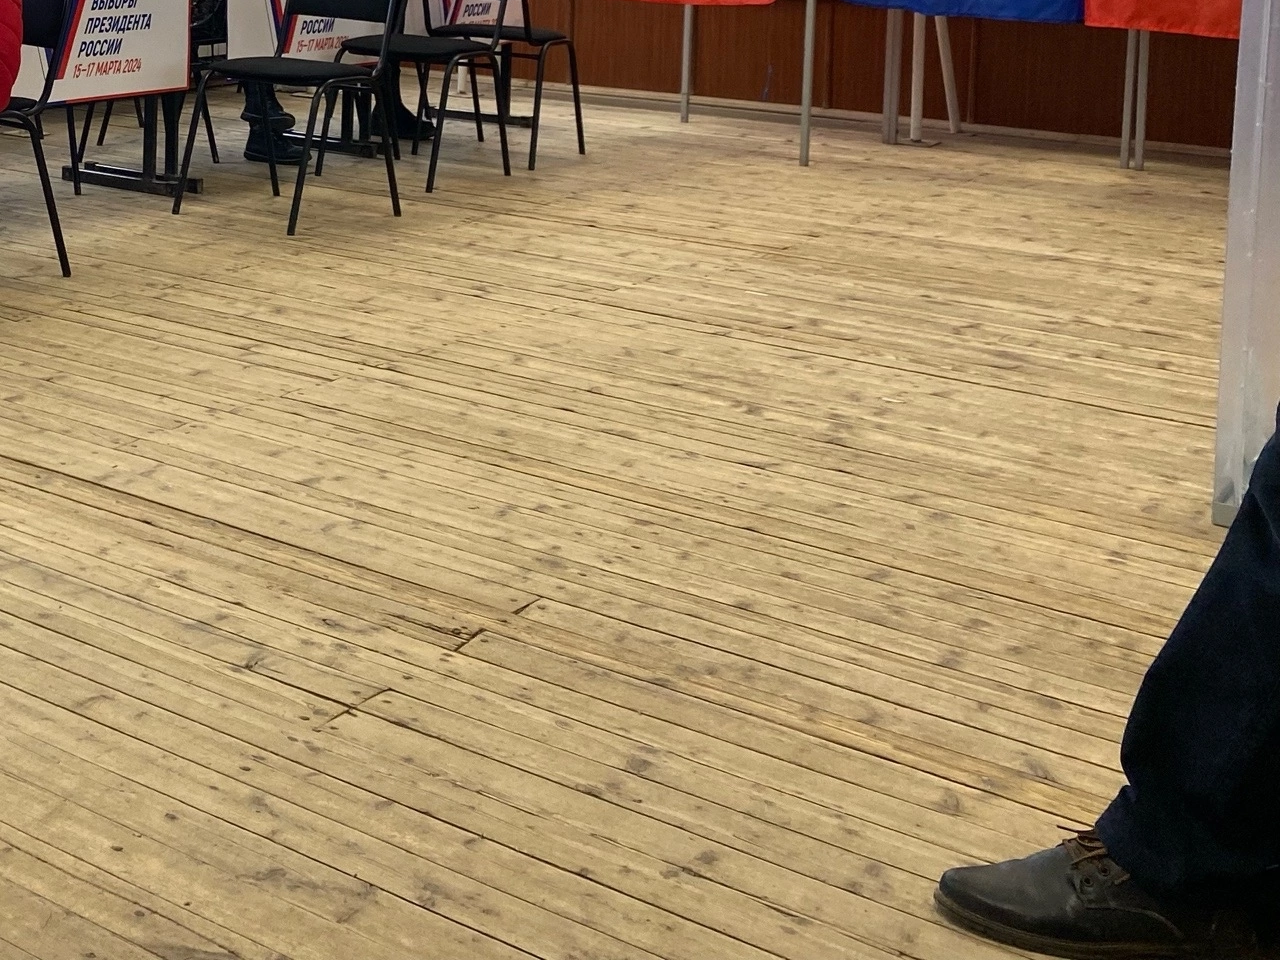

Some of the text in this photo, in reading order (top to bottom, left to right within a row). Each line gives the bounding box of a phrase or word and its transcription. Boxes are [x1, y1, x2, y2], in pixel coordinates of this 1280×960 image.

[462, 3, 492, 17] РОССИИ
[84, 13, 152, 35] ПРЕЗИДЕНТА
[300, 18, 336, 35] РОССИИ
[78, 38, 123, 58] РОССИИ
[95, 60, 123, 76] МАРТА
[122, 58, 142, 74] 2024
